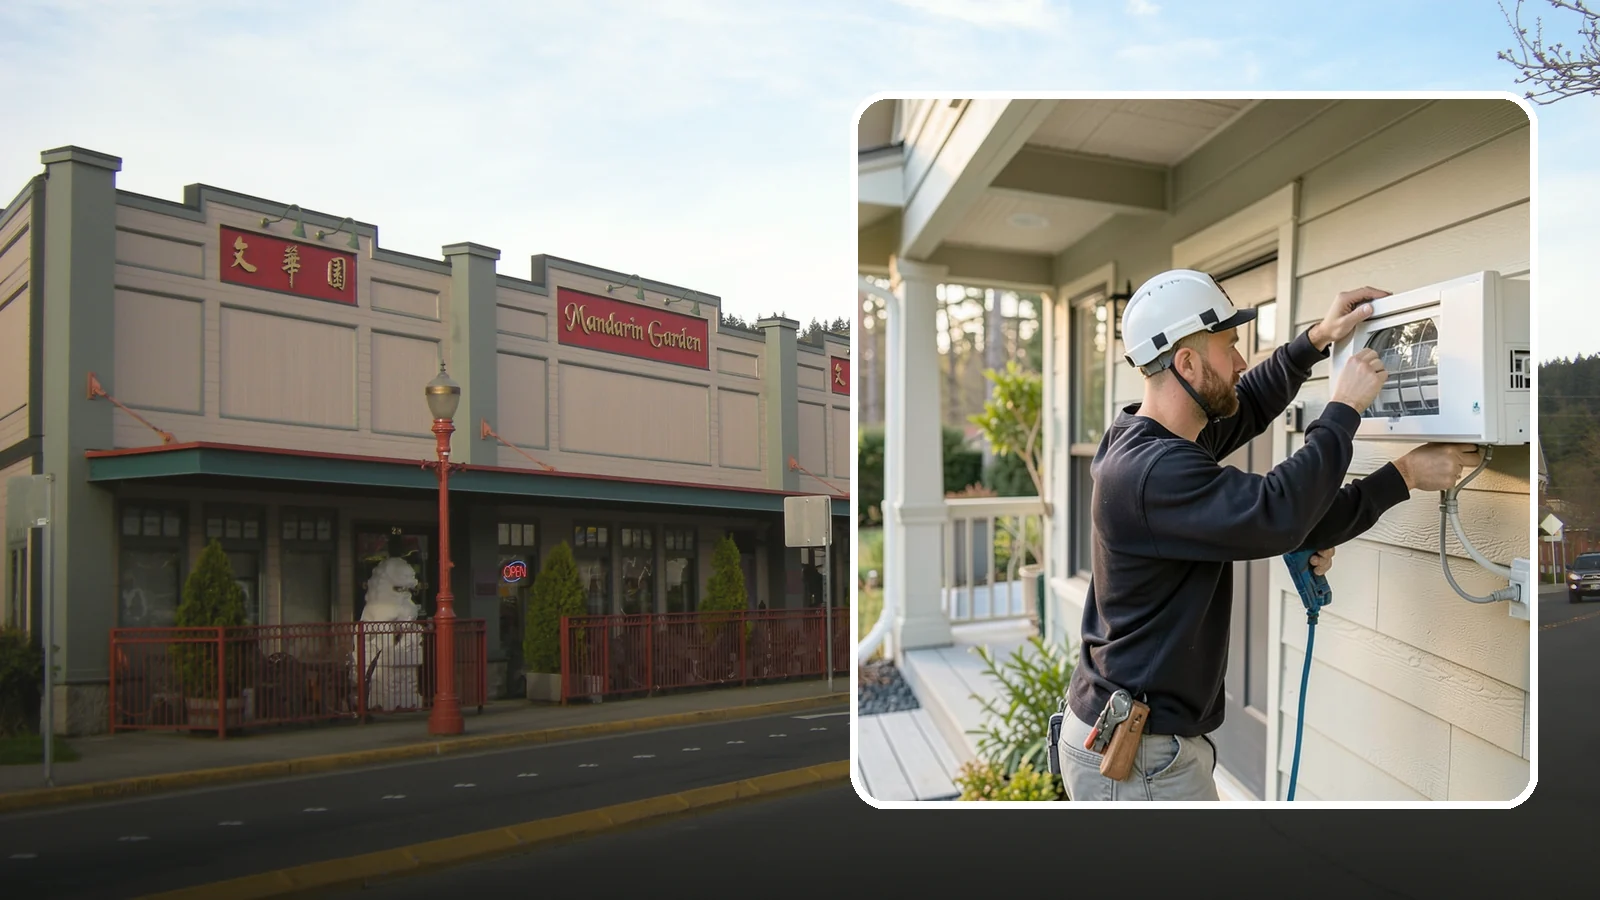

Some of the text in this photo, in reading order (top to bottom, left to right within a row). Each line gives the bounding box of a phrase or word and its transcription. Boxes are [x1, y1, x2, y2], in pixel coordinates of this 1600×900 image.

[230, 235, 346, 291] 文華園
[564, 302, 701, 351] Mandarin Garden
[503, 565, 527, 578] OPEN
